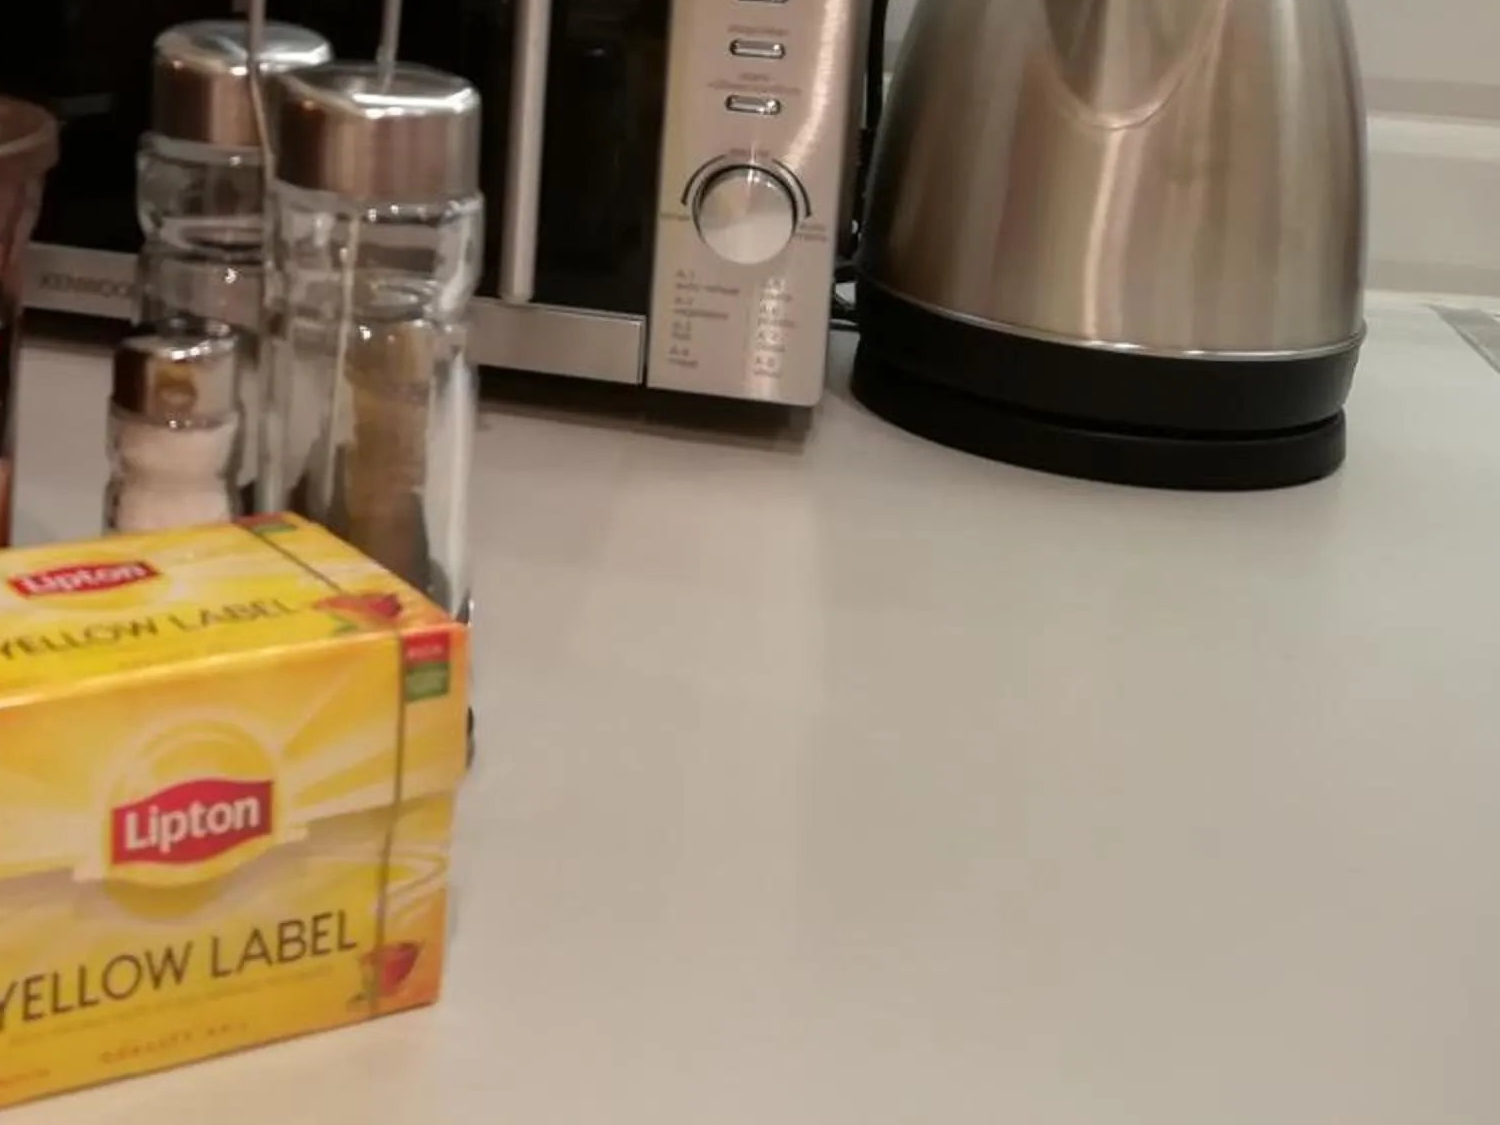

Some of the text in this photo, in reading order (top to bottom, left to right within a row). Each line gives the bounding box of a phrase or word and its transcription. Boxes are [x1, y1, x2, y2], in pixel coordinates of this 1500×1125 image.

[21, 565, 147, 595] Lipton
[170, 597, 301, 632] LABEL
[123, 794, 261, 854] Lipton
[208, 908, 359, 980] LABEL
